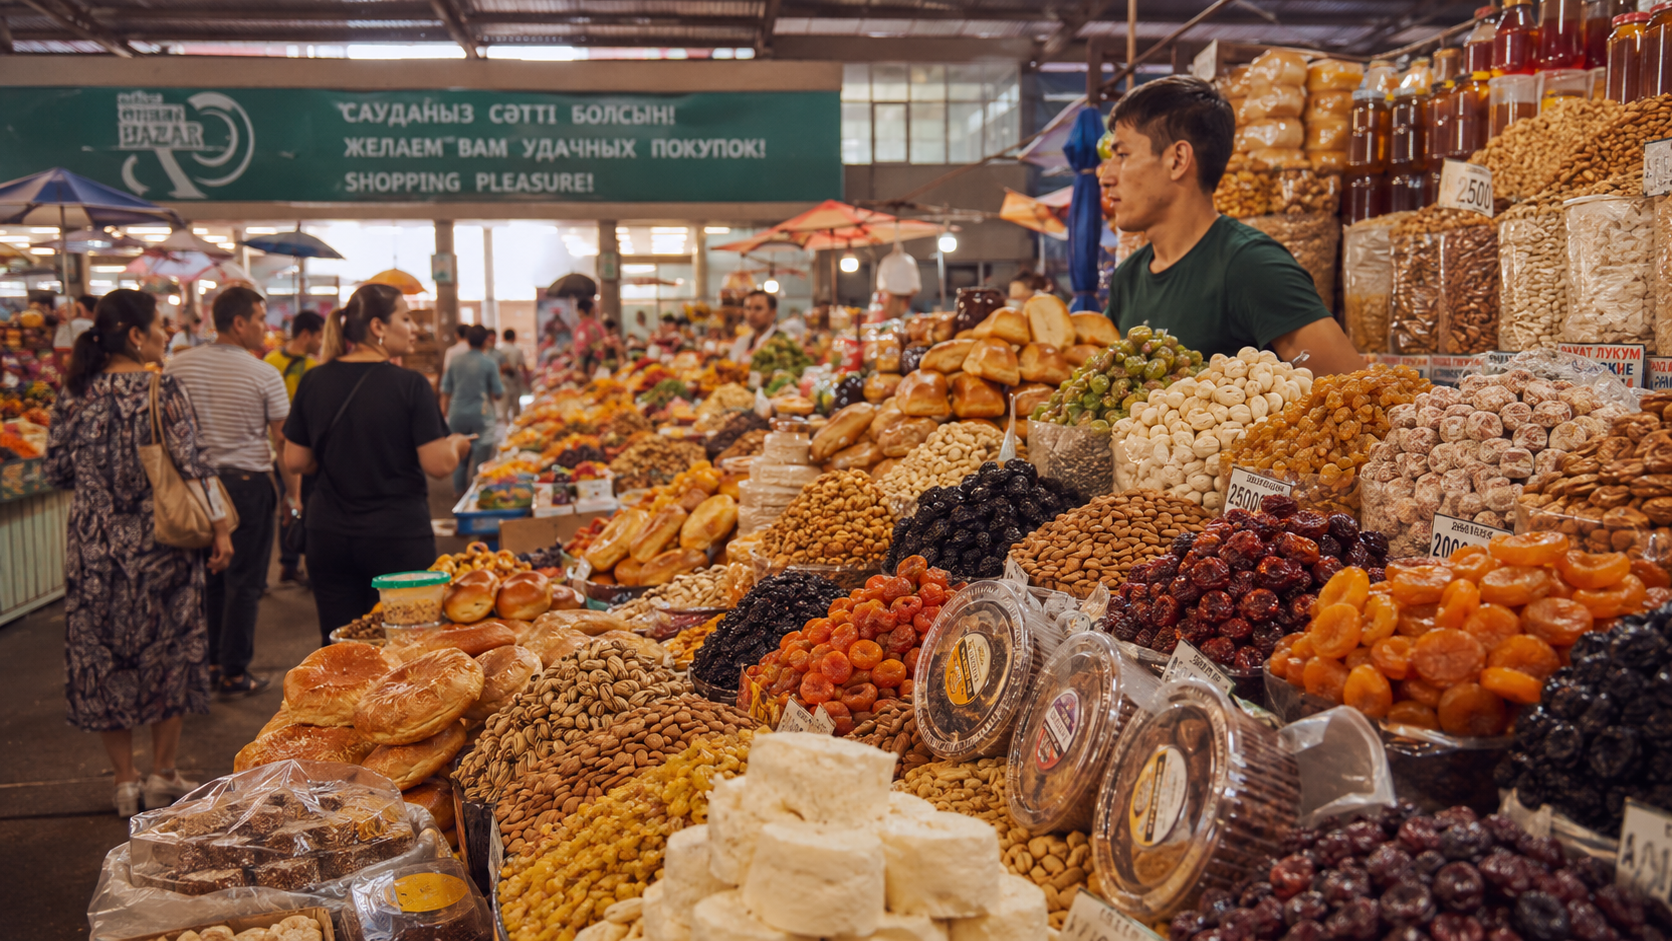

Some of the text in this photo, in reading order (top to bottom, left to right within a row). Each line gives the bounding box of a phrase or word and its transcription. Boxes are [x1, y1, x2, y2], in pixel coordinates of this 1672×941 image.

[489, 103, 558, 125] СӘТТІ
[571, 104, 676, 126] БОЛСЫН!
[343, 136, 767, 163] ЖЕЛАЕМ ВАМ УДАЧНЫХ ПОКУПОК!
[344, 171, 595, 193] SHOPPING PLEASURE!
[1456, 176, 1491, 209] 2500
[1595, 347, 1641, 360] ЛУКУМ
